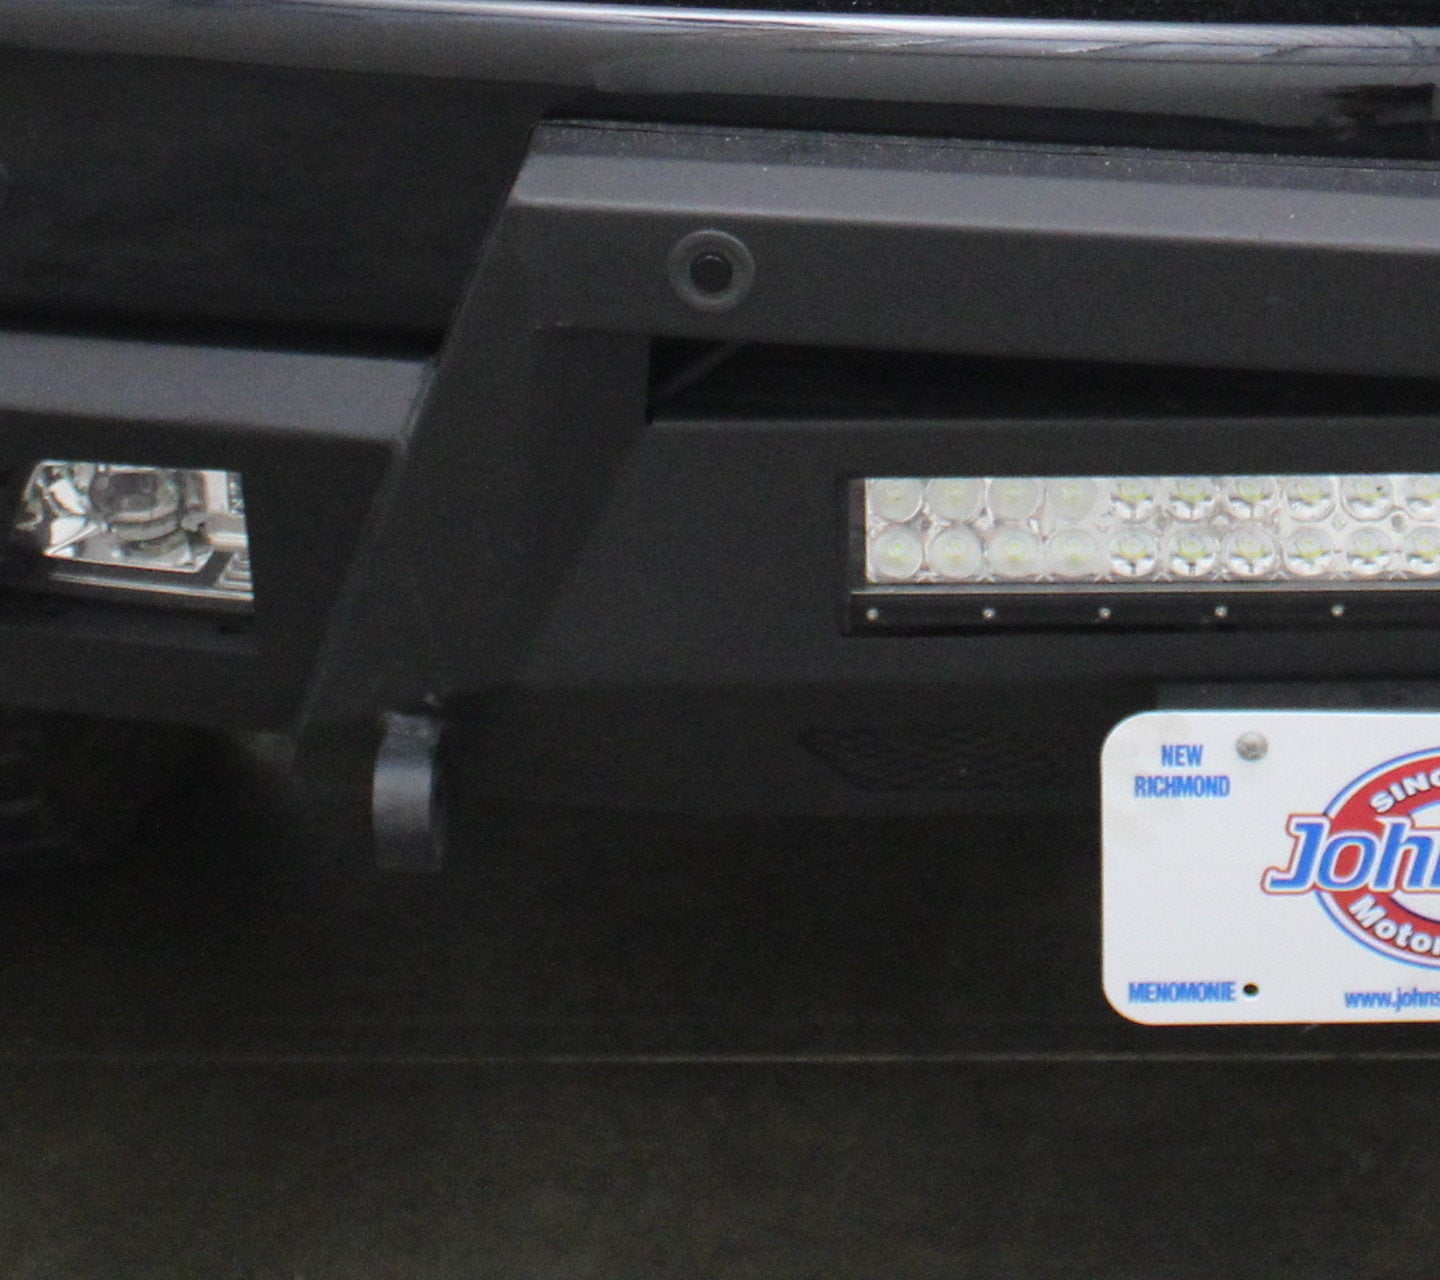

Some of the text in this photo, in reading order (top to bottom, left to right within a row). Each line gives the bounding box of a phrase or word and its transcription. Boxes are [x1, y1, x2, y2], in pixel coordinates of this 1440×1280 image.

[1160, 743, 1205, 768] NEW
[1133, 775, 1232, 800] RICHMOND
[1127, 980, 1237, 1004] MENOMONIE
